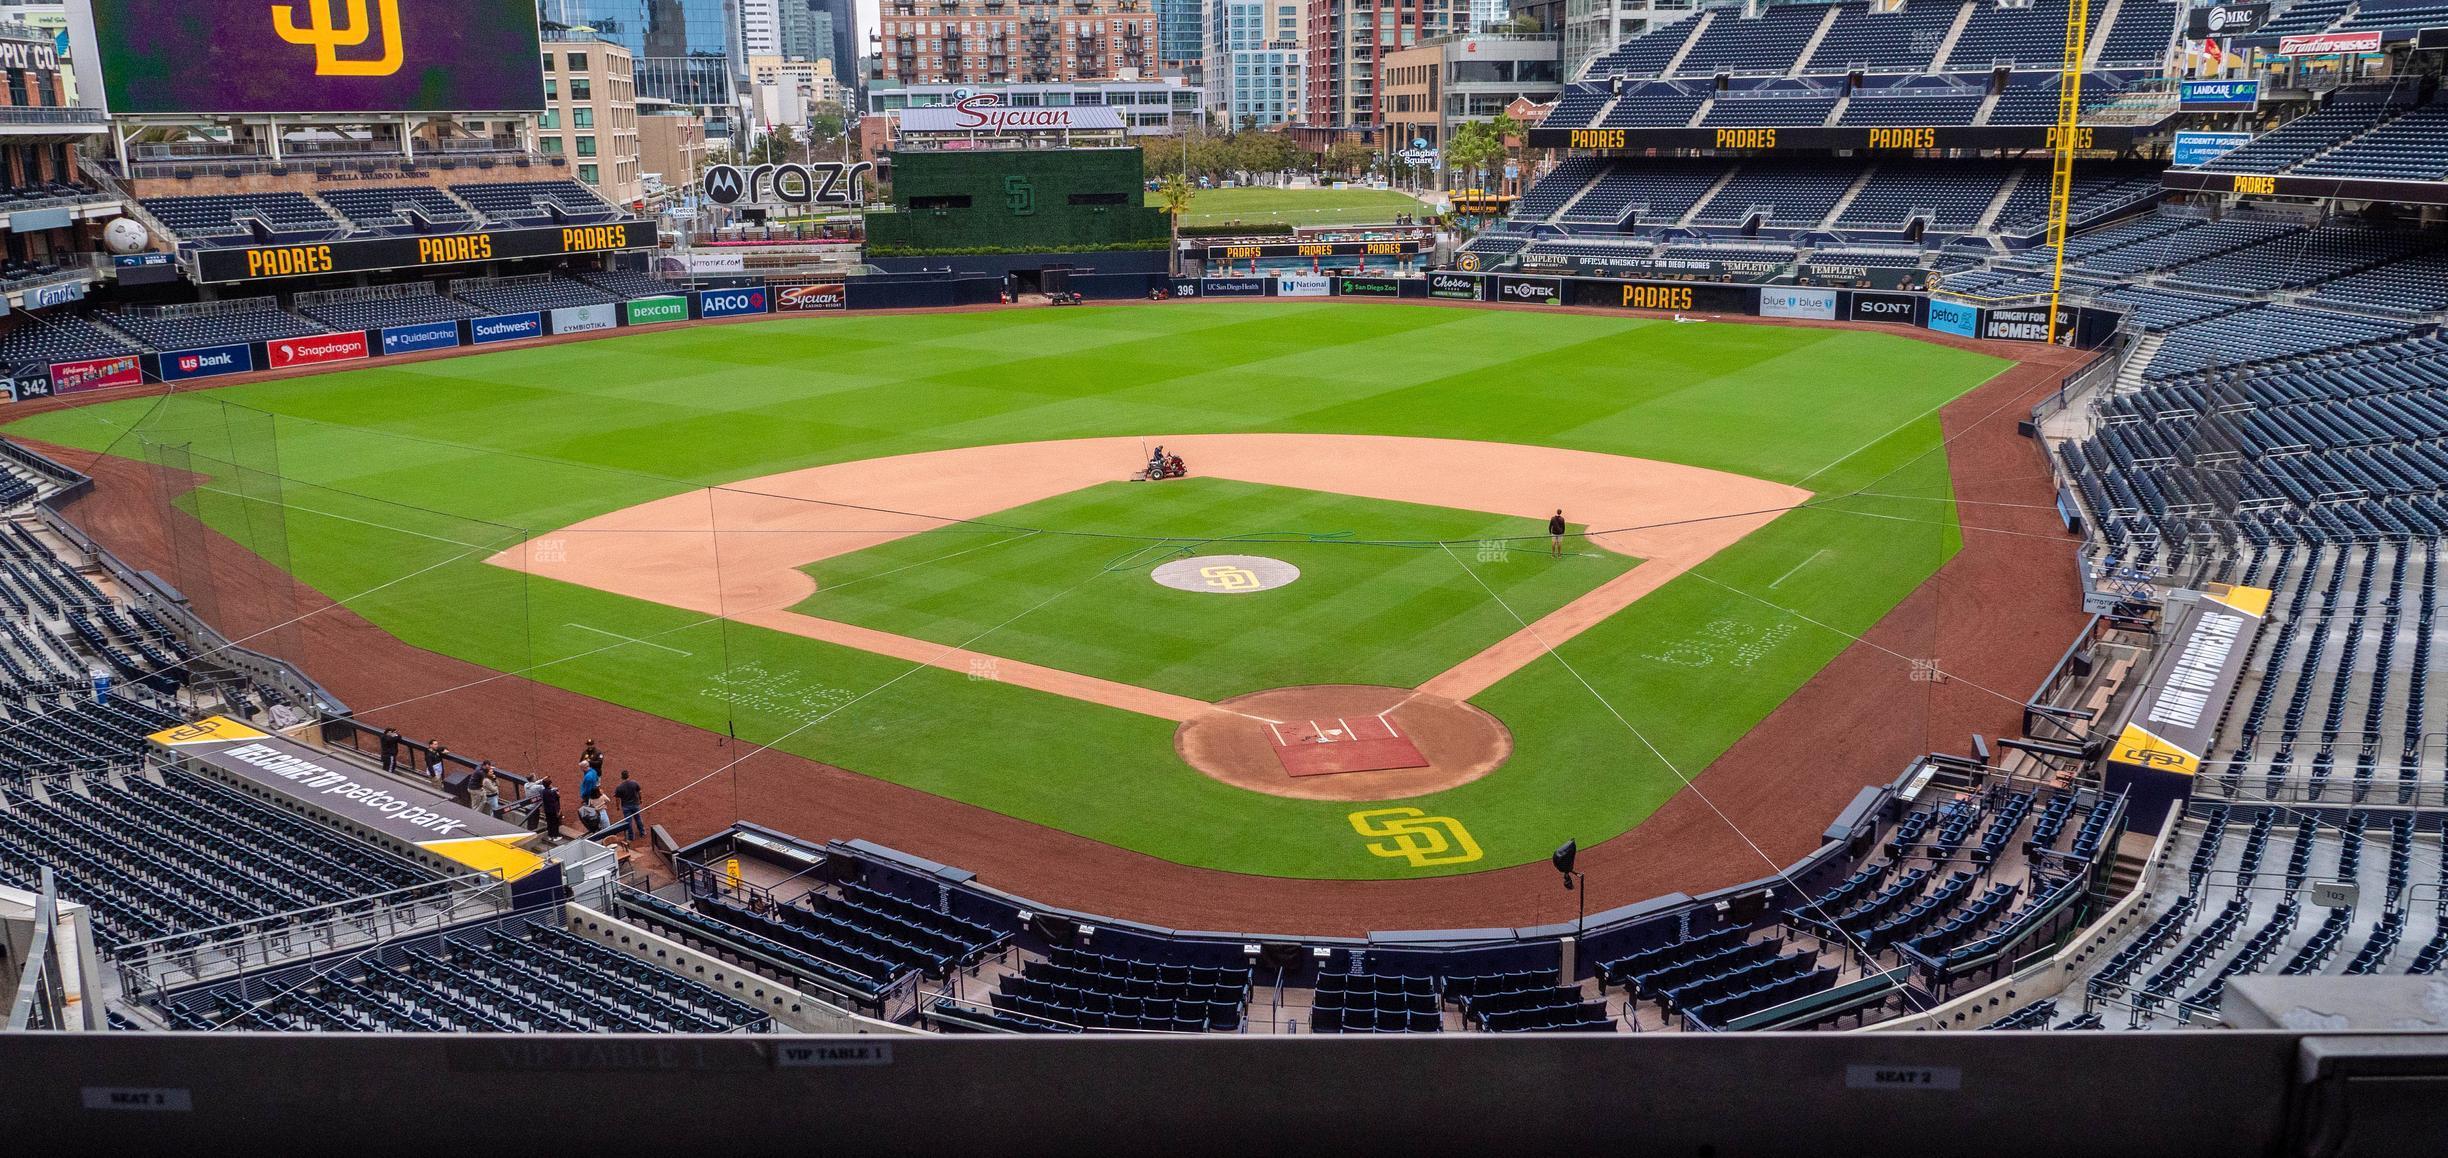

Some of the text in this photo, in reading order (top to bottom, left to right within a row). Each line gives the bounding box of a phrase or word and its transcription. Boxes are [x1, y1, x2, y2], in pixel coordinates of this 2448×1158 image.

[2226, 10, 2252, 23] MRC
[2283, 38, 2333, 53] Tarantino
[34, 44, 60, 70] CO.
[2193, 85, 2230, 95] LANDCARE
[956, 94, 1073, 138] Sycuan
[1571, 129, 1625, 149] PADRES
[1716, 128, 1776, 148] PADRES
[1869, 127, 1935, 149] PADRES
[1399, 149, 1439, 158] Gallagher
[1404, 157, 1433, 166] Square
[317, 172, 430, 182] ESTRELLA JALISCO LANDING
[750, 161, 873, 204] razr
[2233, 175, 2276, 194] PADRES
[563, 225, 626, 252] PADRES
[419, 233, 492, 263] PADRES
[1298, 244, 1333, 256] PADRES
[1367, 243, 1401, 254] PADRES
[248, 245, 333, 276] PADRES
[1521, 254, 1568, 265] TEMPLETON
[1579, 257, 1608, 266] OFFICIAL
[1610, 258, 1639, 267] WHISKEY
[1668, 261, 1686, 269] DIEGO
[1687, 262, 1711, 270] PADRES
[1722, 262, 1775, 273] TEMPLETON
[1810, 265, 1867, 276] TEMPLETON
[1207, 282, 1259, 292] UC San Diego Health
[1367, 284, 1384, 292] Diego
[1433, 275, 1471, 288] Chosen
[38, 284, 76, 307] Canel's
[1177, 284, 1194, 296] 396
[1504, 283, 1554, 298] EVOTEK
[1622, 284, 1693, 310] PADRES
[704, 295, 749, 312] ARCO
[780, 289, 838, 310] Sycuan
[1763, 296, 1786, 306] blue
[1799, 297, 1822, 307] blue
[1860, 301, 1912, 314] SONY
[1931, 307, 1959, 324] petco
[1993, 311, 2046, 322] HUNGRY FOR
[476, 321, 530, 336] Southwest
[563, 322, 607, 332] CYMBIOTIKA
[1987, 321, 2049, 341] HOMERS
[401, 330, 454, 345] QuidelOrtho
[298, 342, 361, 358] Snapdragon
[199, 353, 232, 366] bank
[22, 378, 49, 396] 342
[2148, 685, 2210, 729] THANK
[223, 743, 468, 835] WELCOME TO petco park
[2325, 890, 2345, 901] 103
[786, 1048, 812, 1059] VIP
[817, 1048, 868, 1059] TABLE
[1875, 1071, 1931, 1083] SEAT 2
